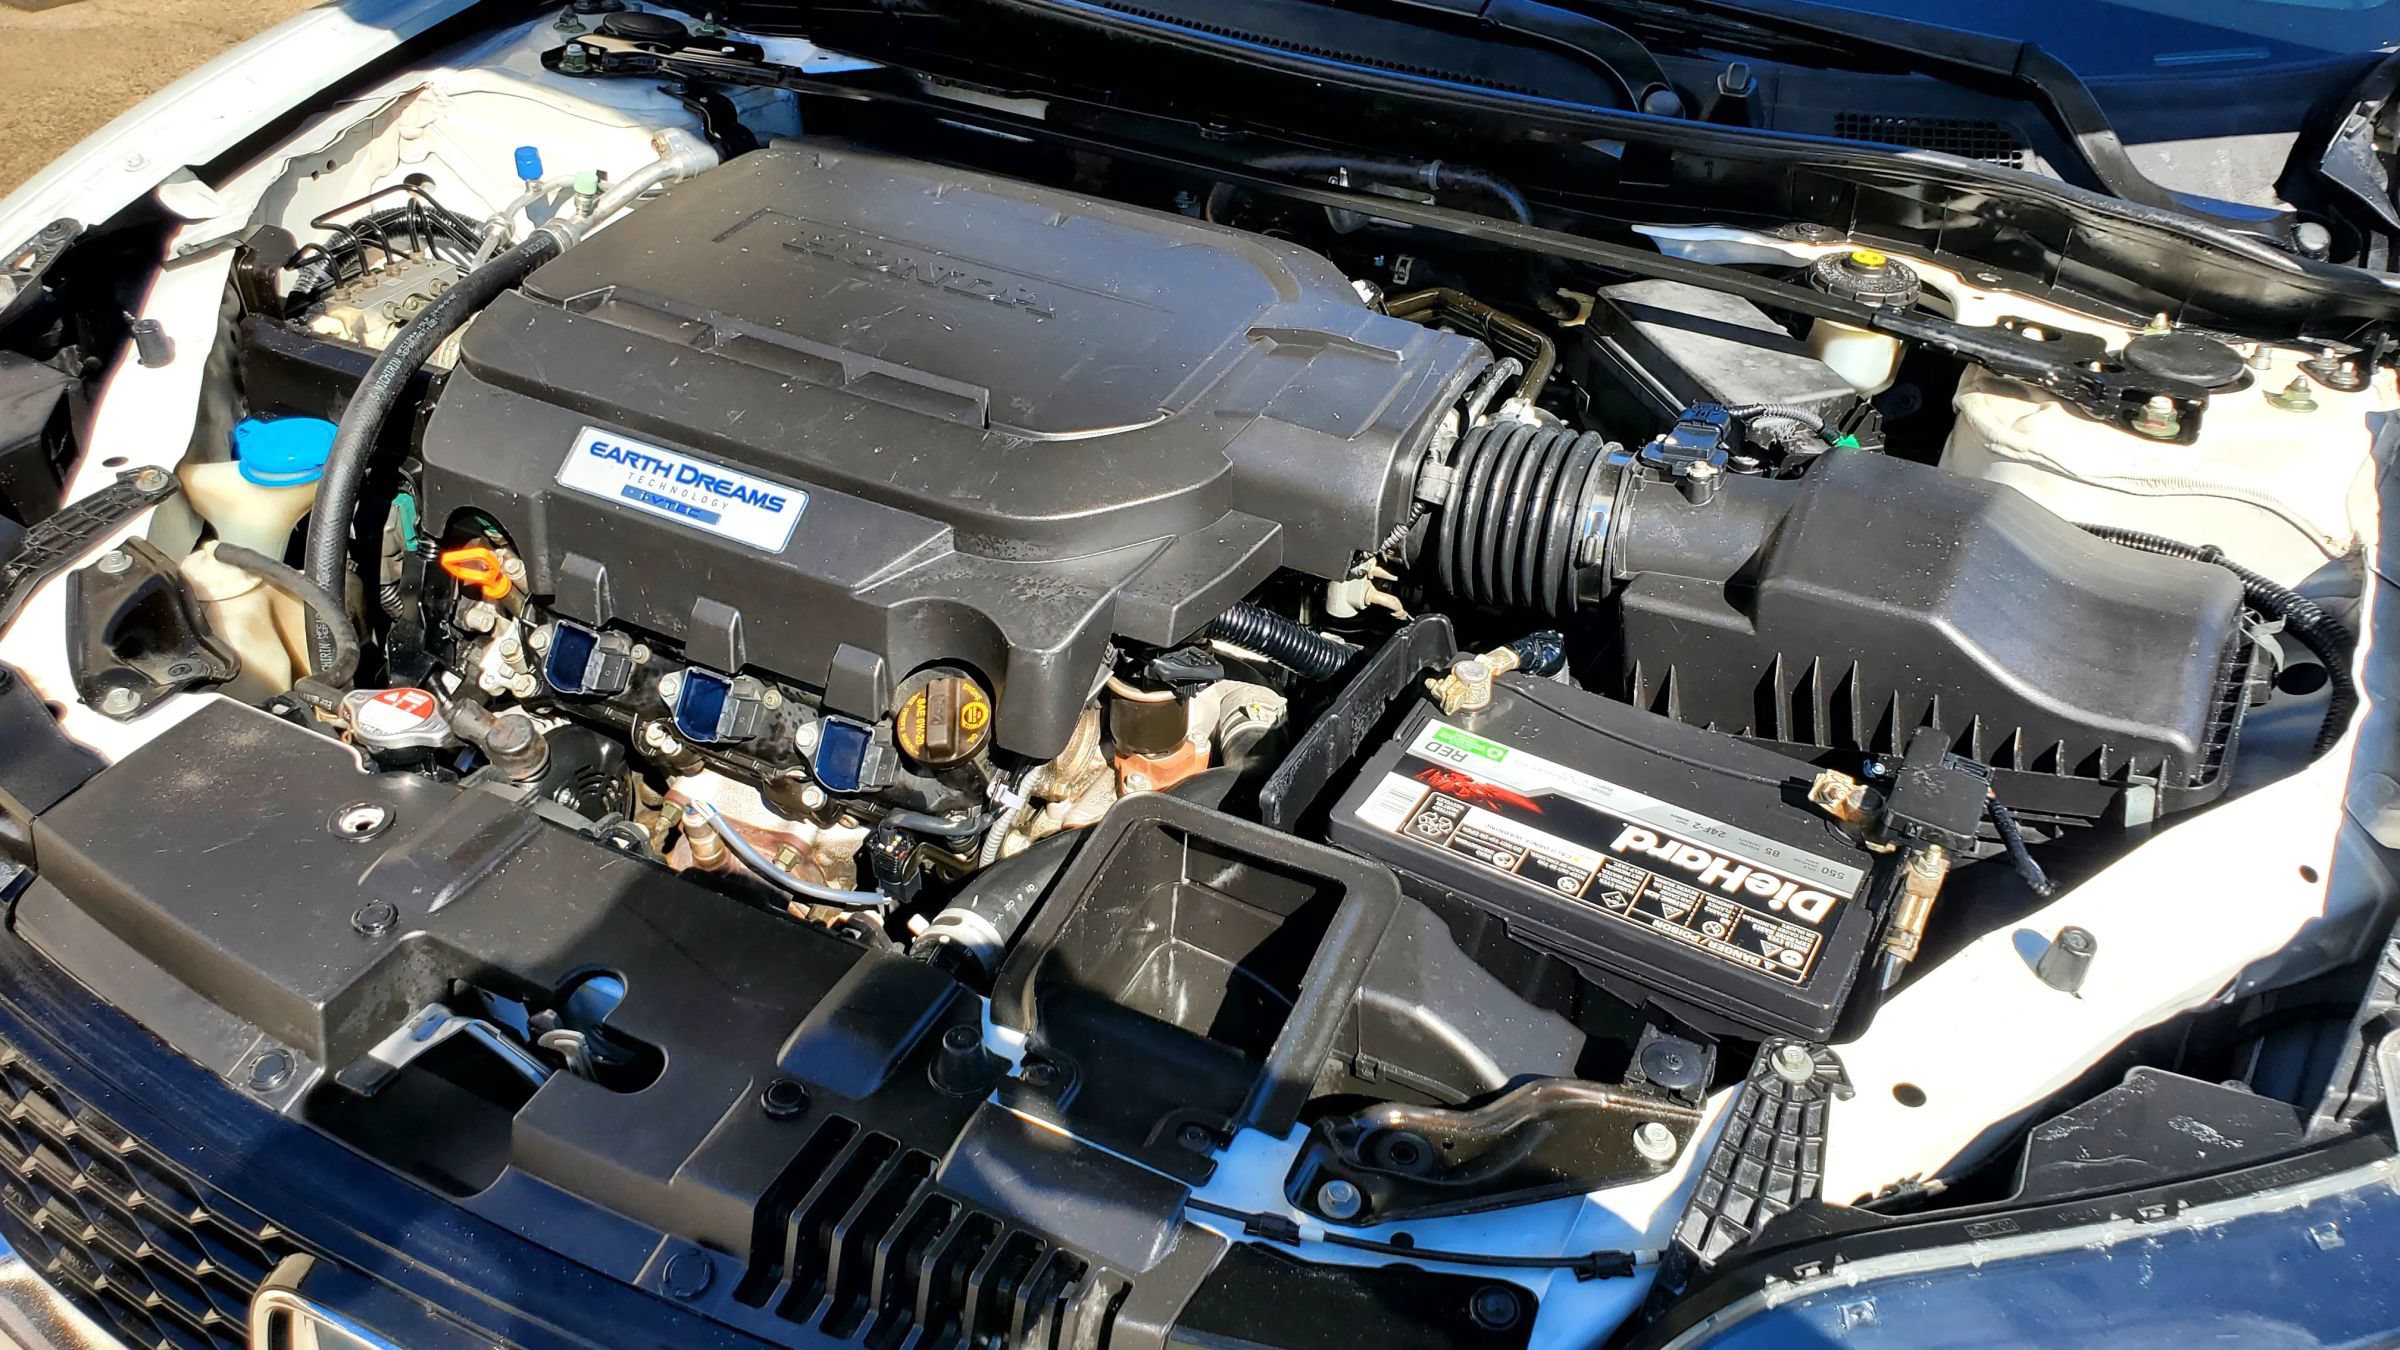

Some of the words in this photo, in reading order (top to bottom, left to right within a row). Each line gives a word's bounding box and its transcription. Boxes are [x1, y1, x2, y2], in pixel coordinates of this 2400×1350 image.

[590, 441, 674, 478] EARTH
[676, 464, 786, 513] DREAMS
[627, 472, 729, 511] TECHNOLOGY
[916, 698, 926, 718] SAE
[916, 719, 925, 745] 0W-20
[967, 733, 978, 743] OIL
[1422, 740, 1469, 763] RED
[1460, 825, 1480, 836] OPEN
[1691, 821, 1727, 838] 24F-2
[1498, 840, 1513, 848] NOT
[1762, 846, 1781, 858] 85
[1566, 864, 1588, 875] REACH
[1567, 870, 1585, 880] KEEP
[1607, 822, 1837, 926] DieHard
[1819, 865, 1846, 880] 550
